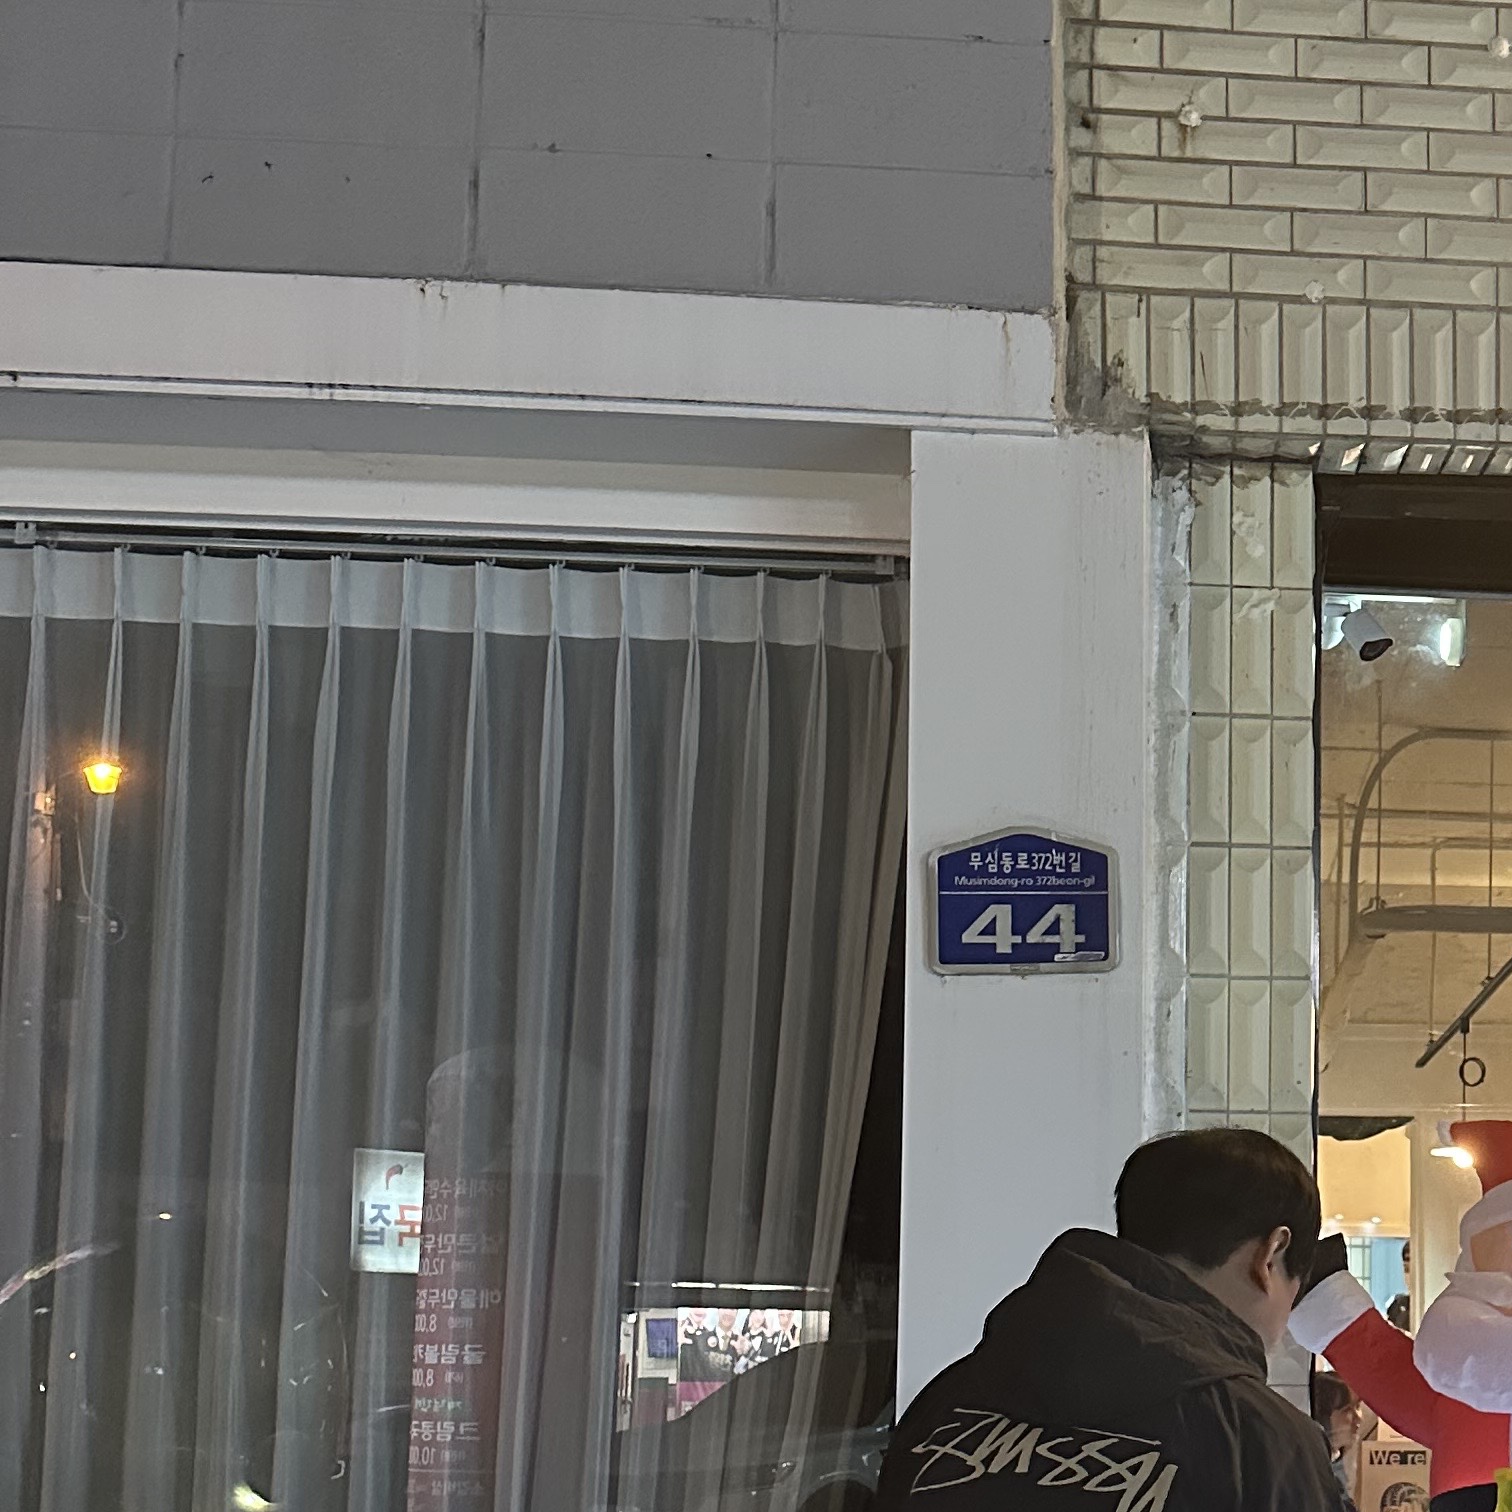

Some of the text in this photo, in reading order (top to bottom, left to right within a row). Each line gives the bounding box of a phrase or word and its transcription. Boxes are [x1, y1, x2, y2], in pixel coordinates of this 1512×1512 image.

[968, 850, 1082, 873] 무심동로372번길
[954, 876, 1096, 888] Musimdong-ro 372beon-gil
[961, 903, 1086, 954] 44
